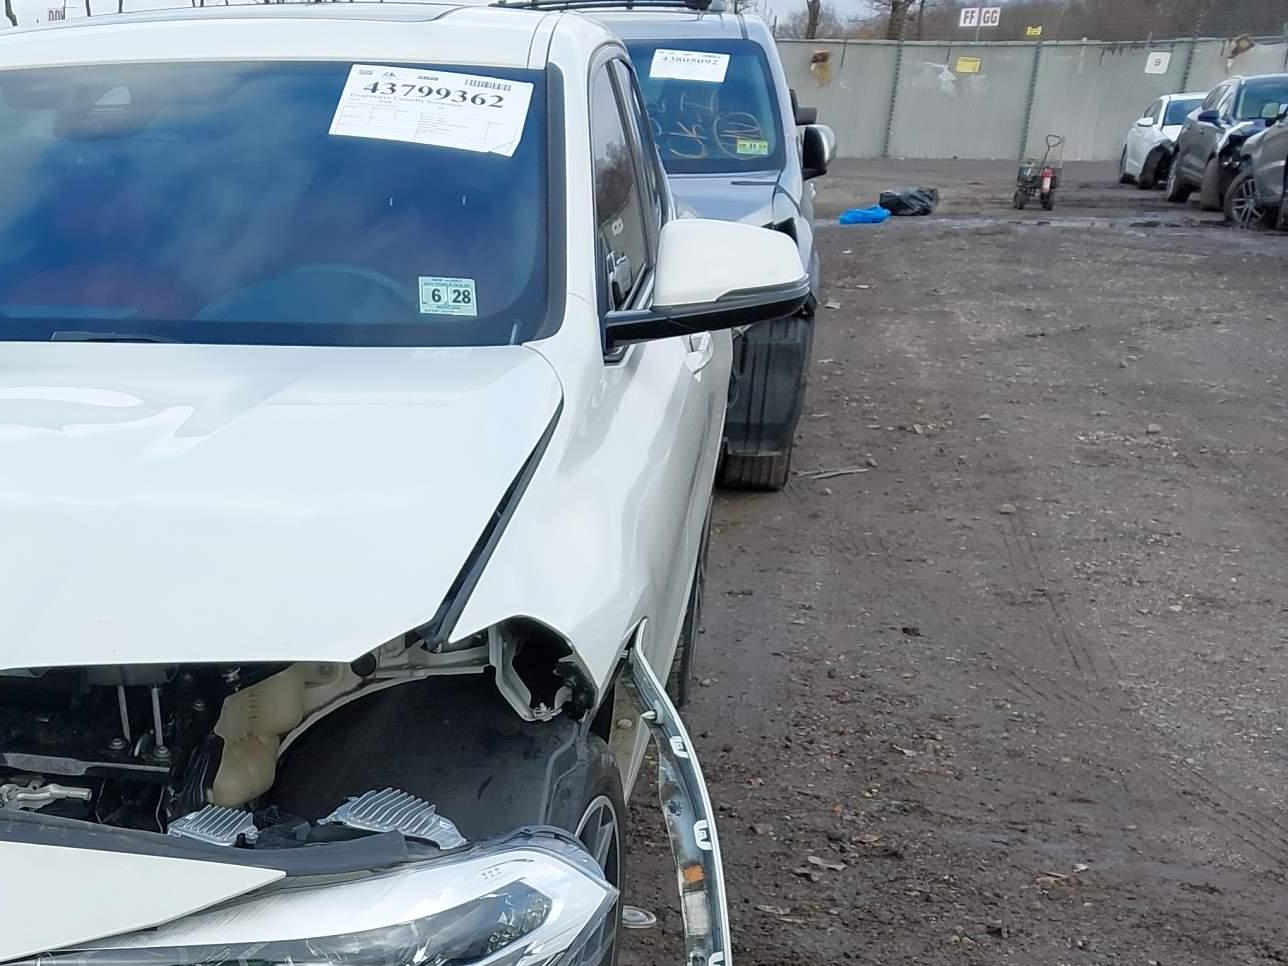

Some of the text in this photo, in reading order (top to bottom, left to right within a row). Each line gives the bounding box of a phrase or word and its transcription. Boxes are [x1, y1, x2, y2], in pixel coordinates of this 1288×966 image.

[963, 9, 977, 24] FF
[983, 9, 998, 24] GG
[363, 81, 505, 109] 43799362
[431, 288, 472, 305] 6 28
